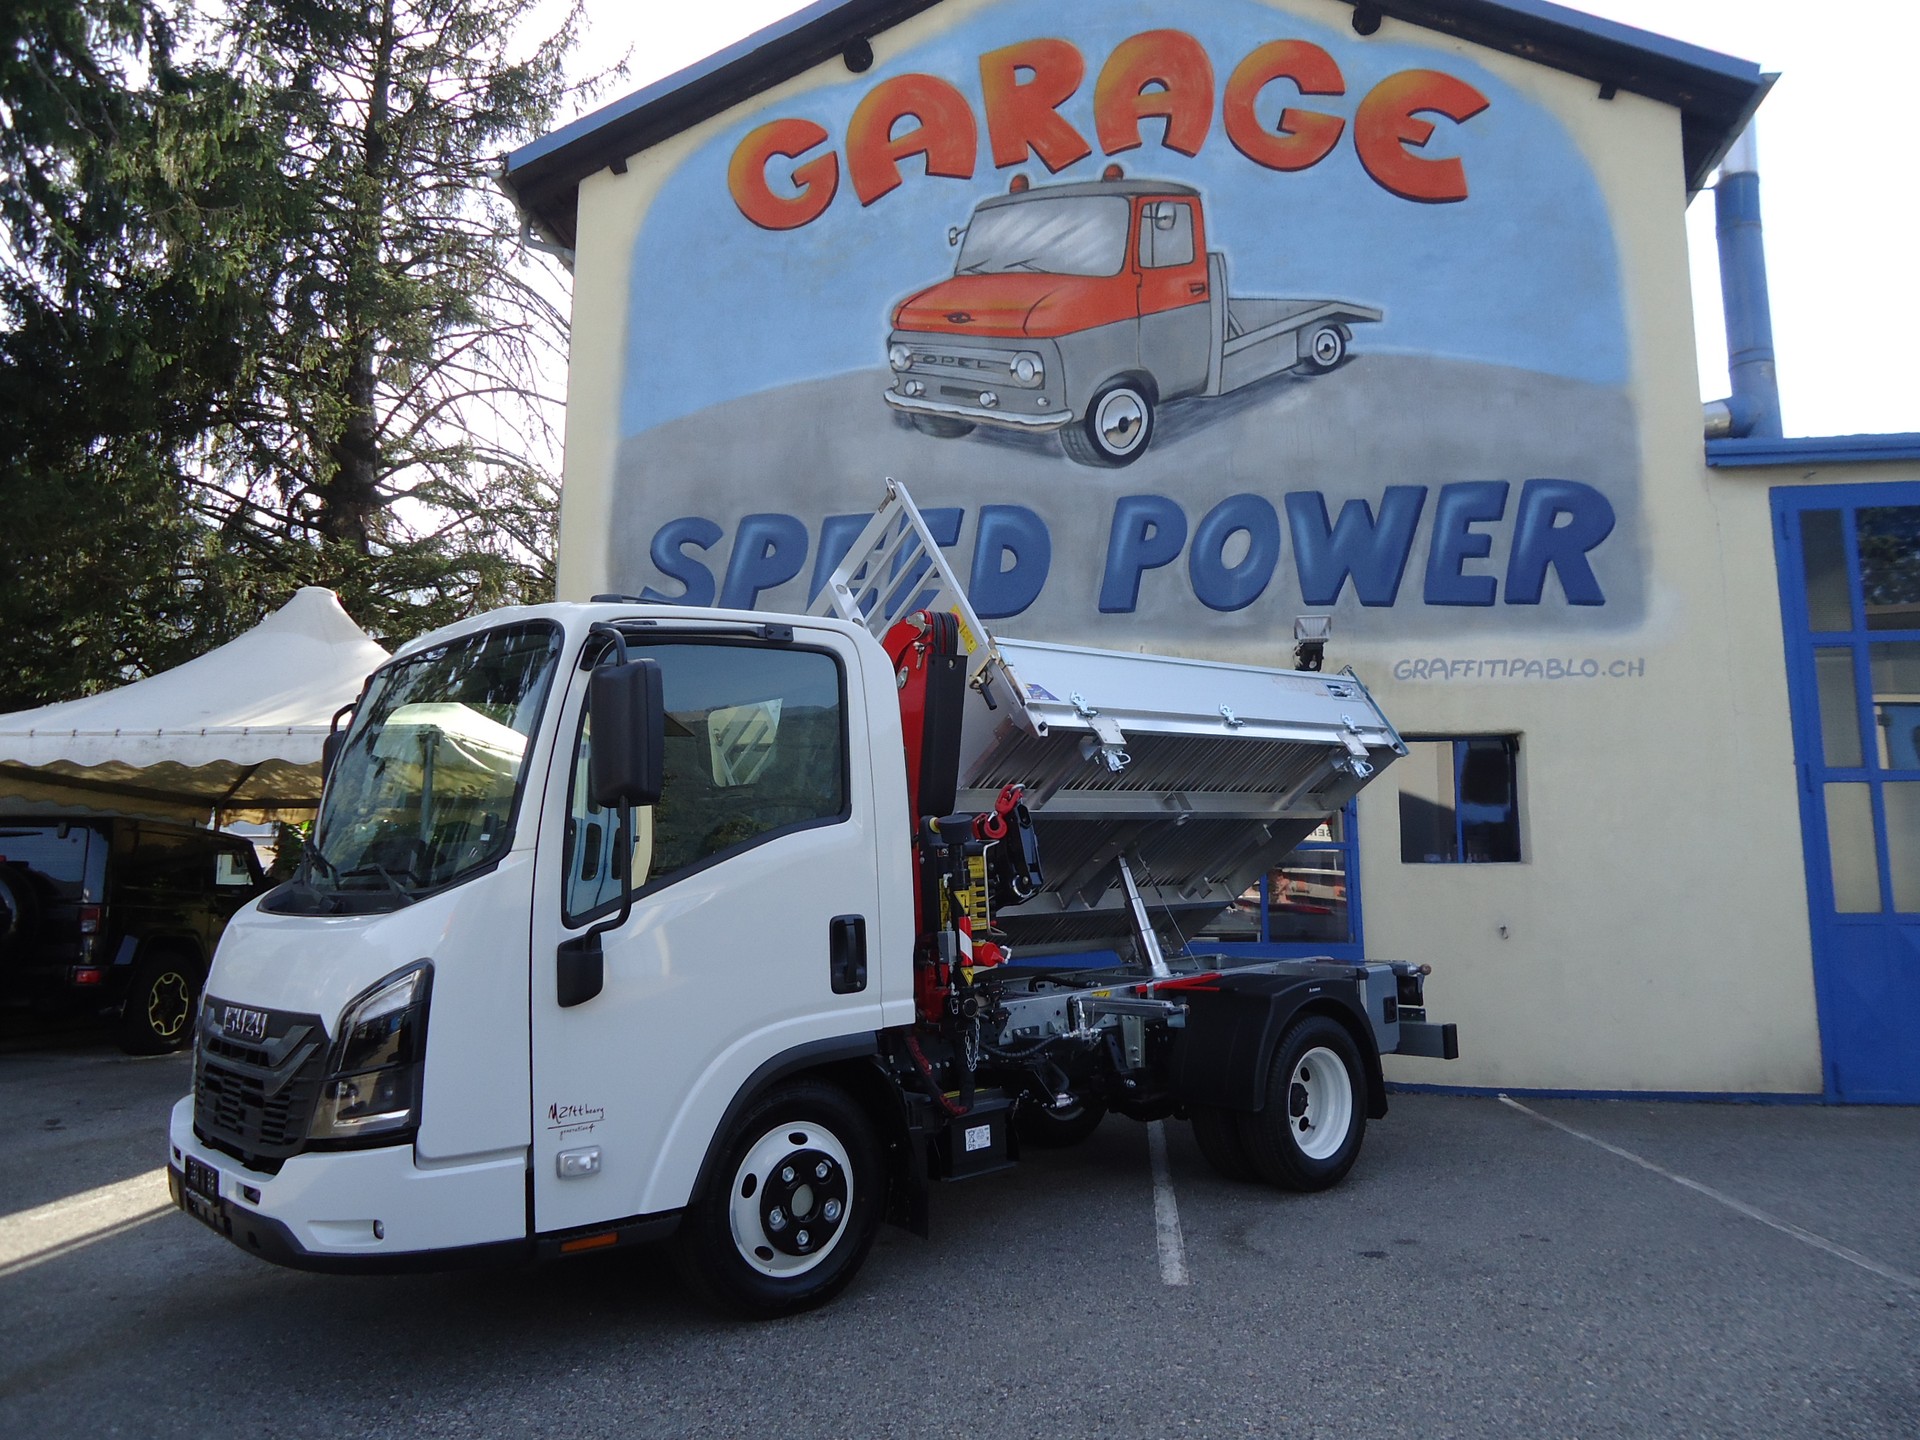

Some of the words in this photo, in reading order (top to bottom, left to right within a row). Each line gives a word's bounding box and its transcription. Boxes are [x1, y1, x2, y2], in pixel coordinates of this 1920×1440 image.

[727, 28, 1490, 231] GARAGE
[922, 354, 991, 369] OPEL
[1098, 478, 1617, 613] POWER
[1393, 657, 1646, 681] GRAFFITIPABLO.CH
[223, 1006, 268, 1039] ISUZU
